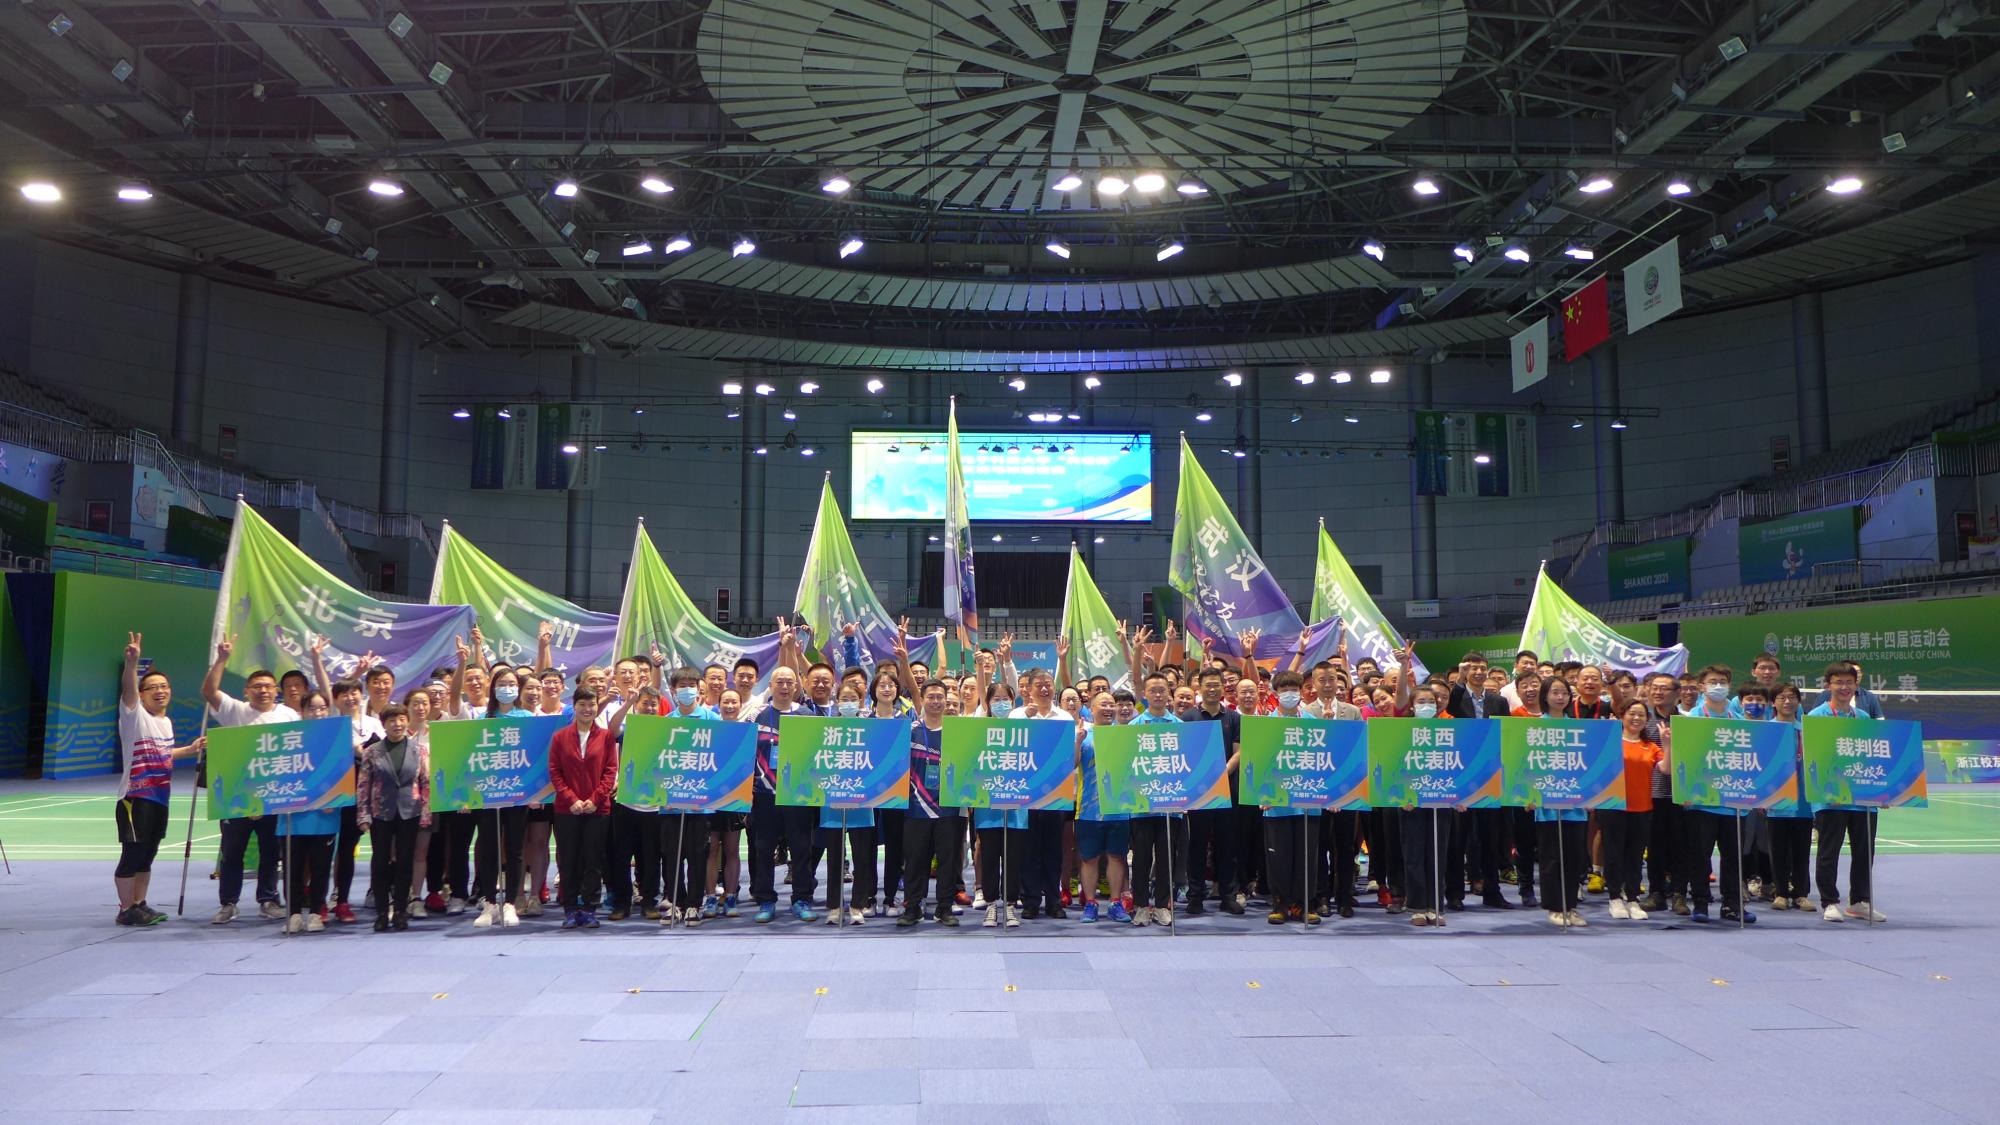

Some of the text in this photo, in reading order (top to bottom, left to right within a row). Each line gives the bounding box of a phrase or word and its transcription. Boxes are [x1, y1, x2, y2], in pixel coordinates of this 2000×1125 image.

[1196, 515, 1266, 592] 武汉
[297, 584, 399, 640] 北京
[672, 612, 745, 673] 上海
[1783, 628, 1951, 651] 中华人民共和国第十四届运动会
[1880, 650, 1914, 660] REPUBLIC
[1926, 649, 1952, 659] CHINA
[256, 730, 304, 753] 北京
[476, 727, 520, 747] 上海
[668, 727, 712, 748] 广州
[823, 726, 866, 747] 浙江
[986, 727, 1028, 748] 四川
[1137, 732, 1179, 753] 海南
[1283, 727, 1327, 748] 武汉
[1412, 727, 1455, 748] 陕西
[1526, 727, 1587, 747] 教职工
[1714, 727, 1752, 748] 学生
[1836, 737, 1892, 759] 裁判组
[248, 752, 315, 778] 代表队
[469, 749, 531, 772] 代表队
[658, 749, 718, 772] 代表队
[814, 749, 874, 771] 代表队
[977, 750, 1037, 771] 代表队
[1131, 754, 1191, 775] 代表队
[1276, 750, 1335, 772] 代表队
[1404, 750, 1464, 771] 代表队
[1527, 750, 1588, 772] 代表队
[1705, 750, 1762, 772] 代表队
